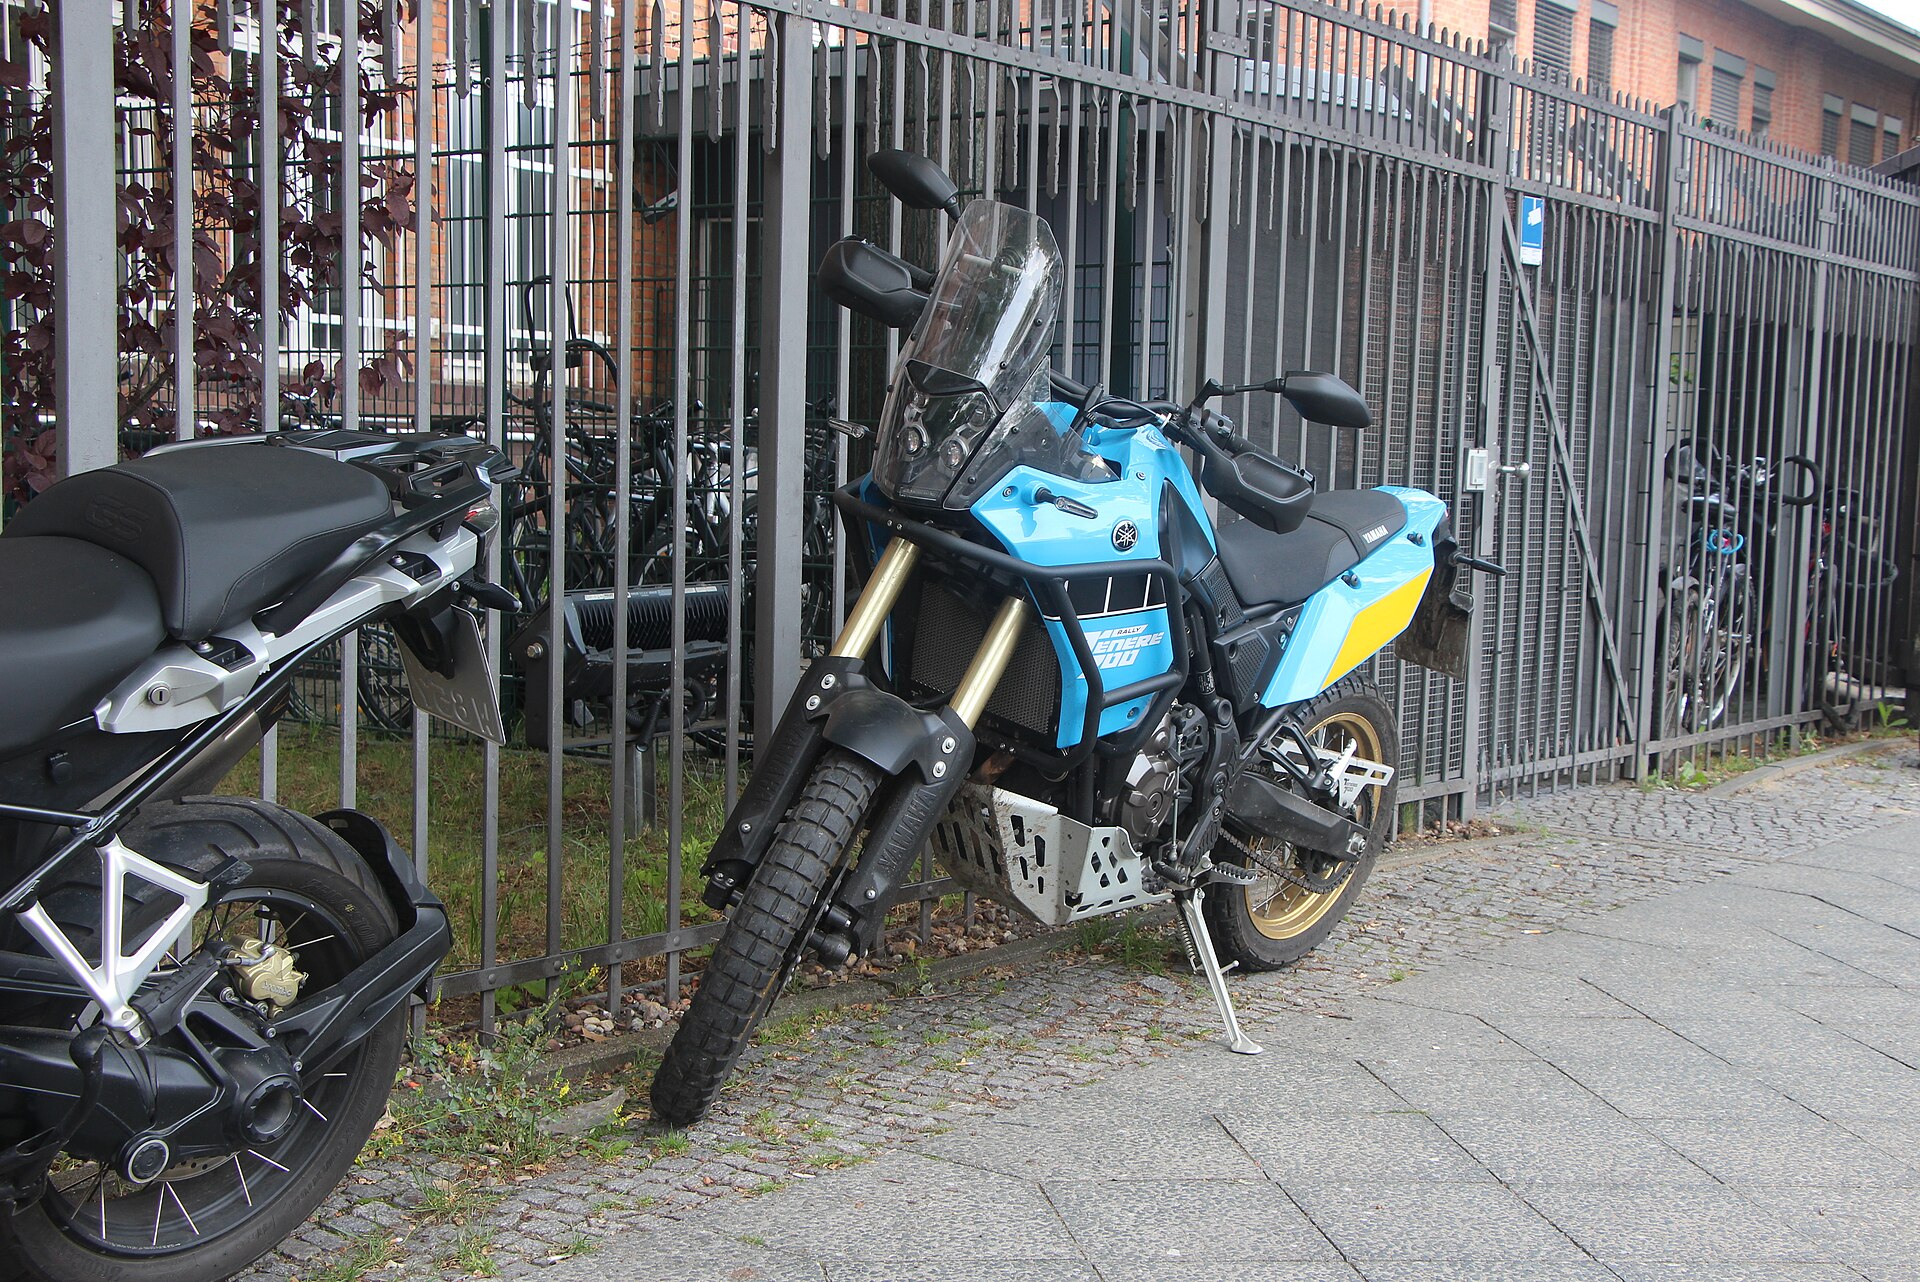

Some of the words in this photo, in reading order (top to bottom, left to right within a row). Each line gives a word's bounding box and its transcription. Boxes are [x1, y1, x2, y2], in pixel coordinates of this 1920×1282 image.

[1362, 525, 1389, 543] YAMAHA
[1116, 626, 1142, 636] RALLY
[877, 787, 937, 874] YAMAHA
